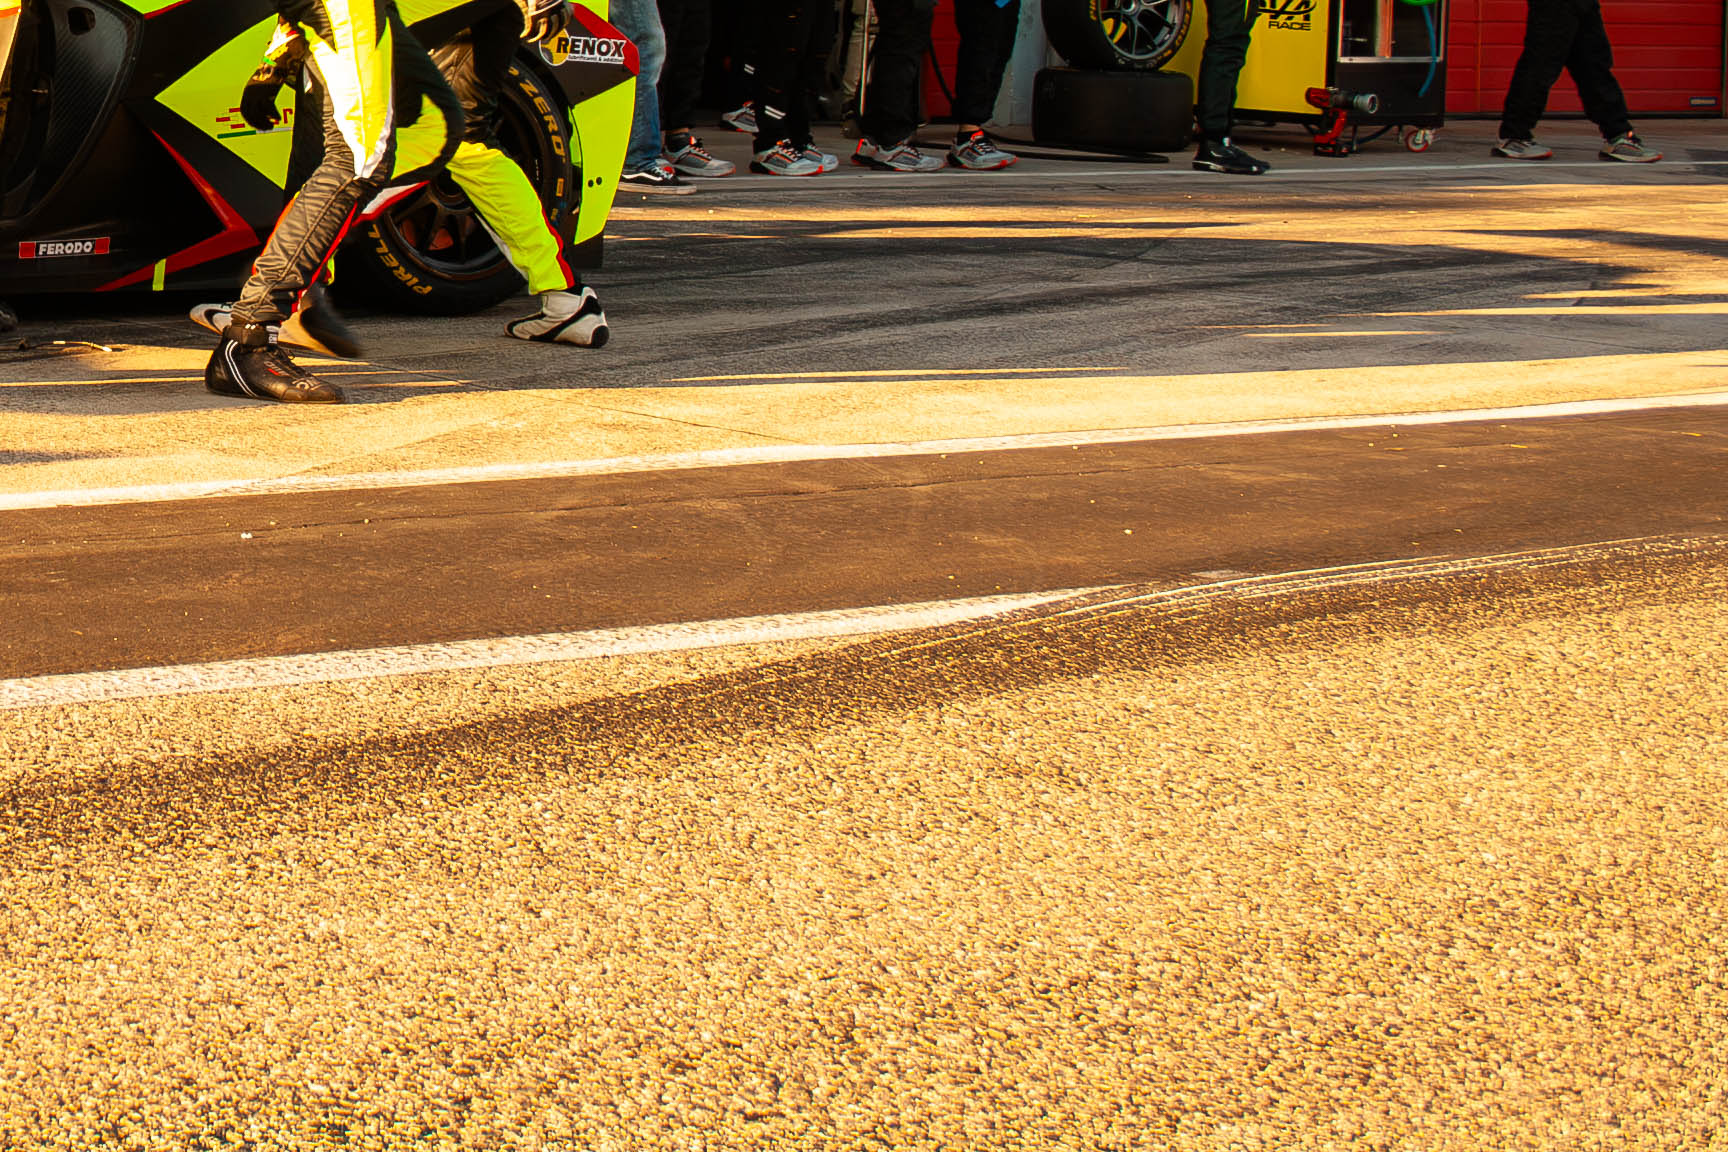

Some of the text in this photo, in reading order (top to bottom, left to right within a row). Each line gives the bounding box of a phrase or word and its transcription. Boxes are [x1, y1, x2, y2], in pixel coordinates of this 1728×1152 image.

[1268, 20, 1312, 31] RACE
[556, 36, 625, 58] RENOX
[519, 79, 566, 157] ZERO
[38, 241, 93, 256] FERODO
